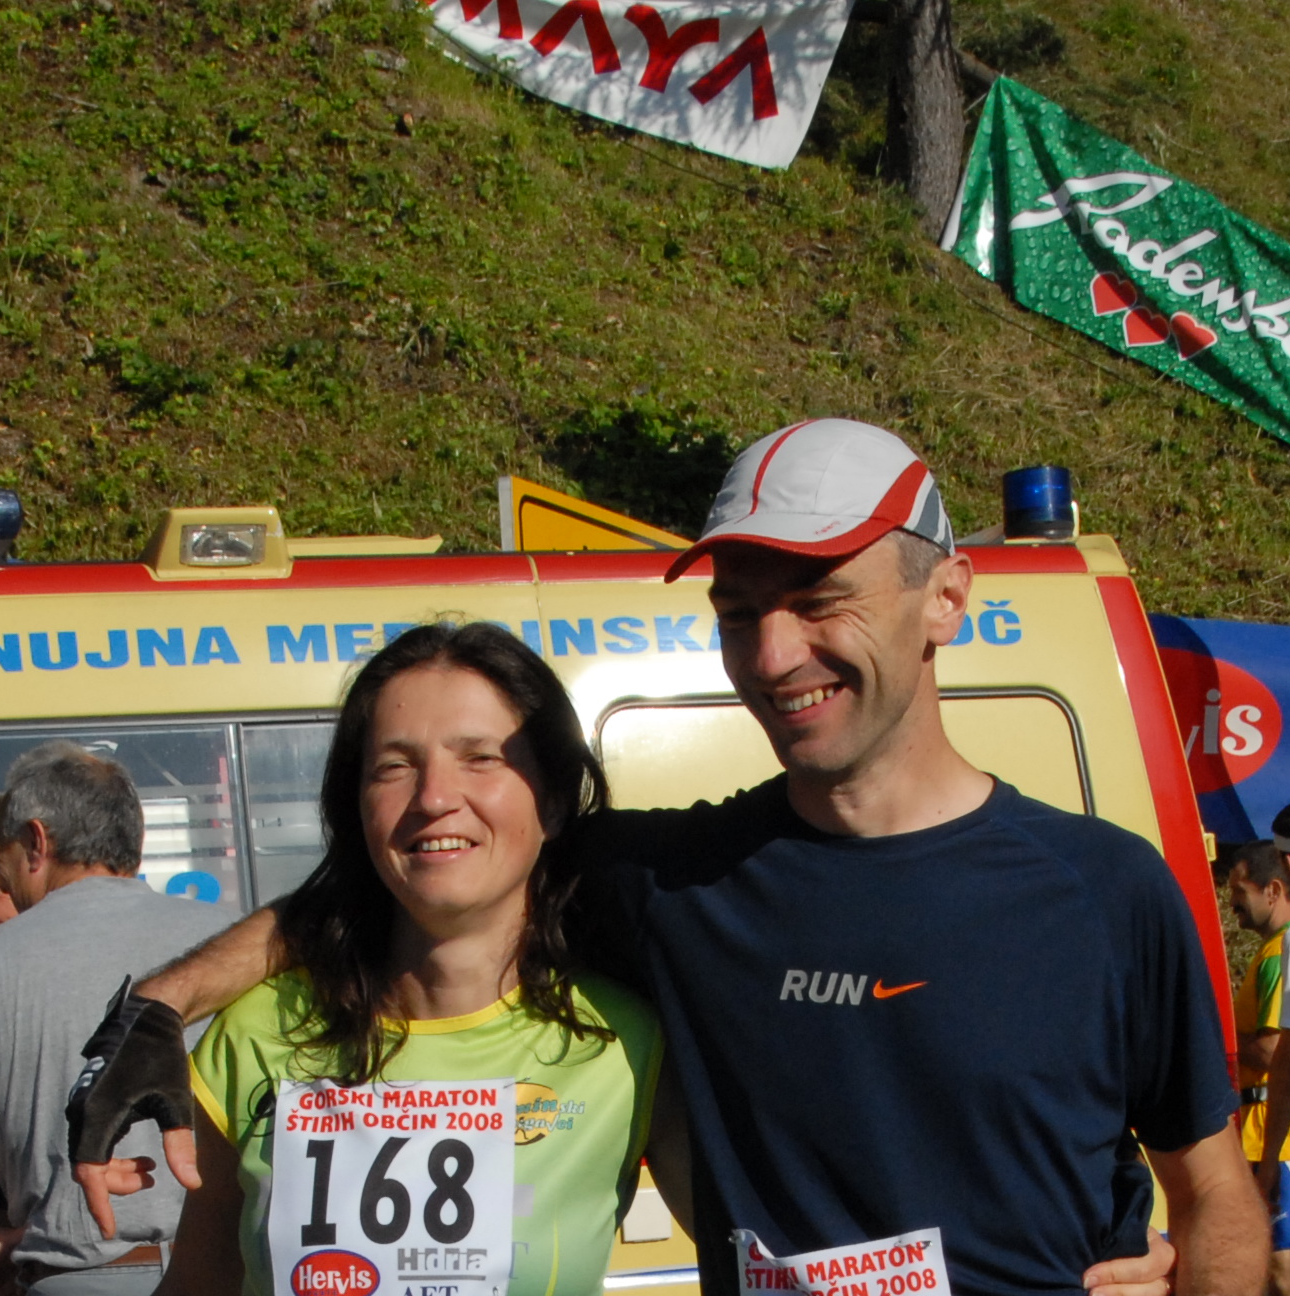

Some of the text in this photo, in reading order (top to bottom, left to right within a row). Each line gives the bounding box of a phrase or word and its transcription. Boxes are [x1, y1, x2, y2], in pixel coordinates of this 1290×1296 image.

[780, 969, 868, 1005] RUN
[298, 1087, 497, 1110] GORSKI MARATON
[286, 1108, 503, 1133] ŠTIRIH OBČIN 2008
[301, 1136, 475, 1247] 168
[299, 1263, 373, 1296] Hervis
[805, 1241, 925, 1284] MARATON
